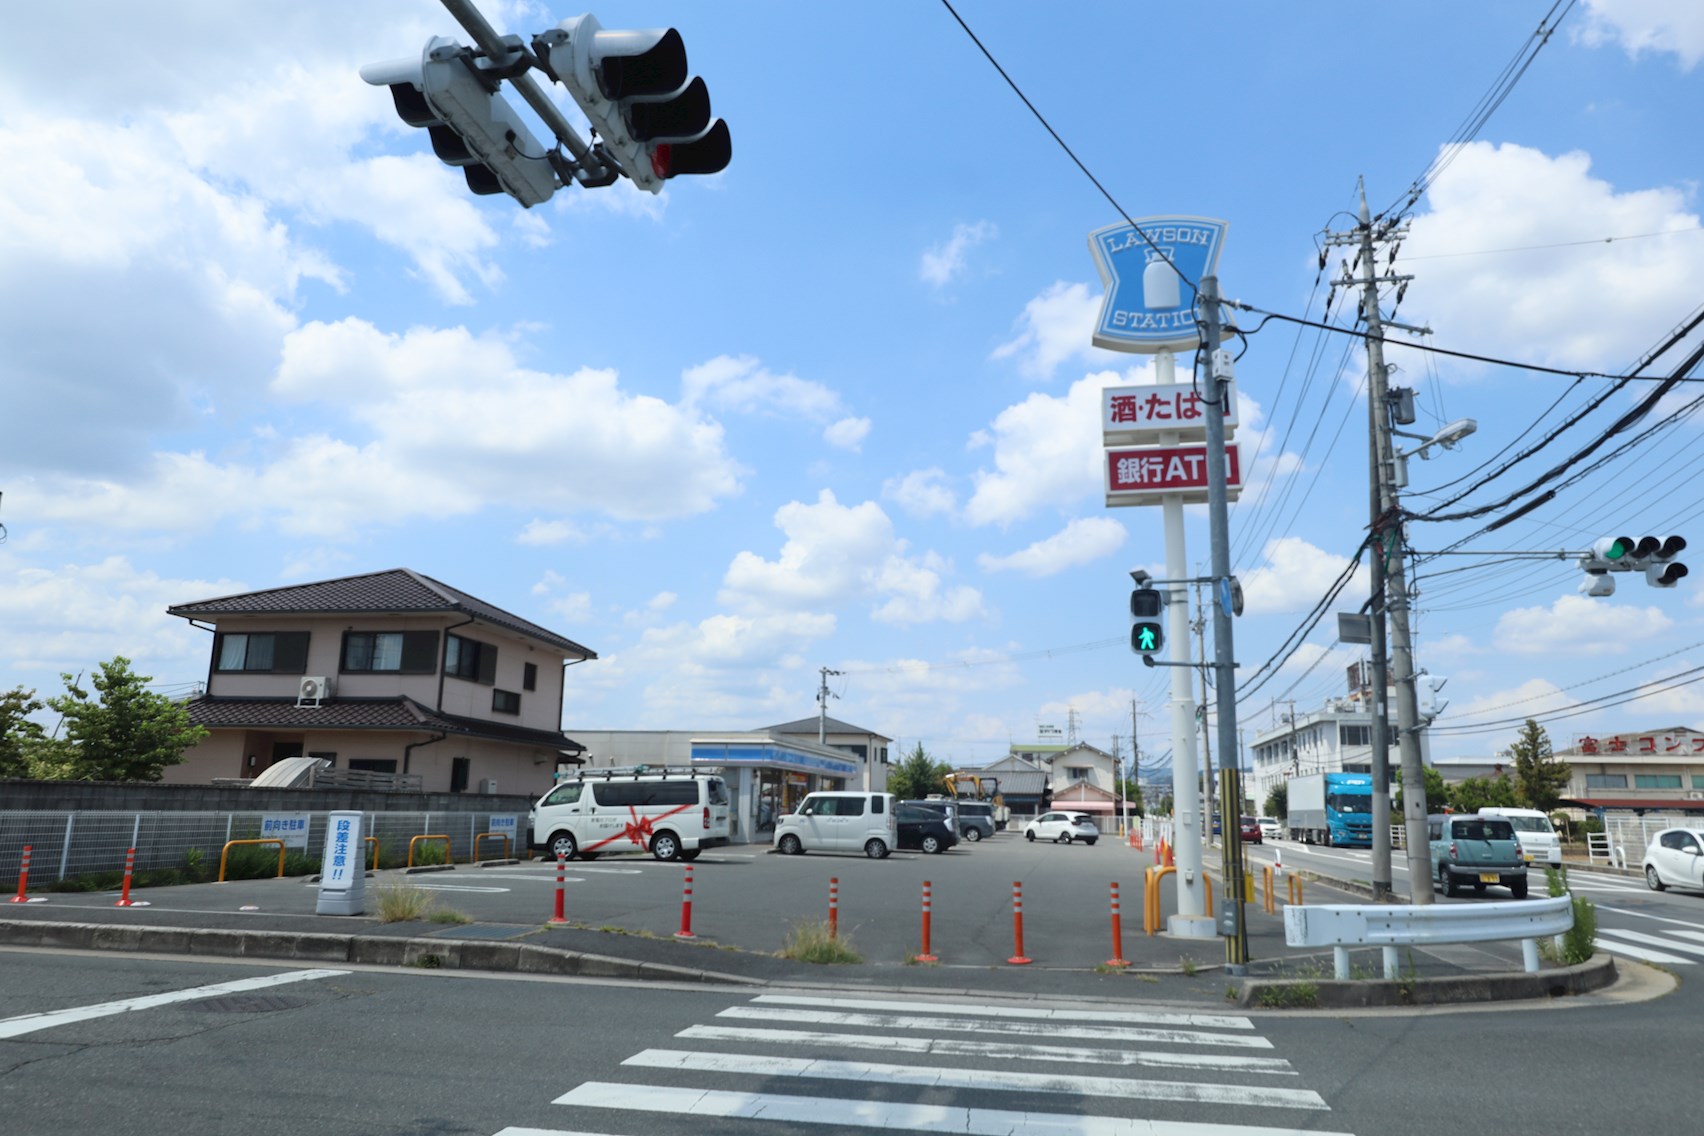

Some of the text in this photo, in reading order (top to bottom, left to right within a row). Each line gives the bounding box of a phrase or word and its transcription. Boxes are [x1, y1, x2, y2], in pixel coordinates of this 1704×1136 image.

[1108, 228, 1210, 252] LAWSON
[1113, 309, 1201, 328] STATIO
[1110, 391, 1231, 423] 酒・たば
[264, 819, 305, 831] 前向き駐車
